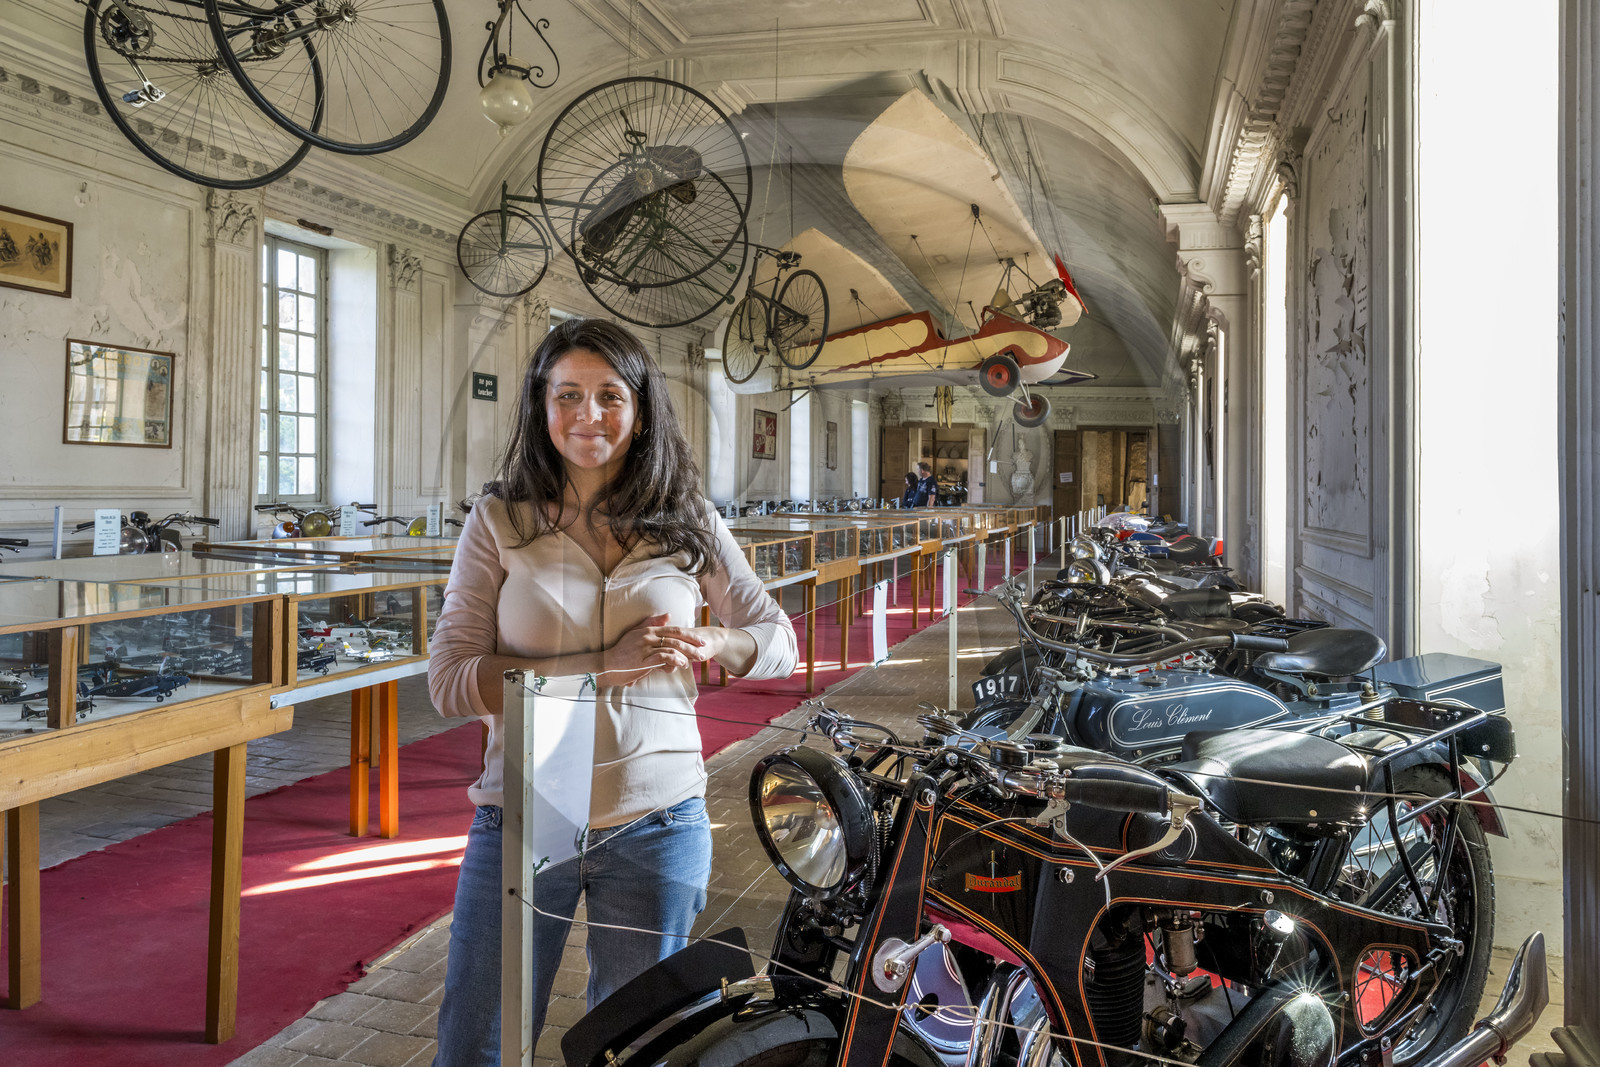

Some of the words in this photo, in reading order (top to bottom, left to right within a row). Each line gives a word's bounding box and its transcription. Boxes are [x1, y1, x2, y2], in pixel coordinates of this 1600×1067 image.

[478, 388, 494, 396] toucher
[975, 676, 1018, 700] 1917
[1127, 708, 1163, 732] Louis
[1165, 703, 1213, 726] Clément
[969, 875, 1019, 888] Durandal
